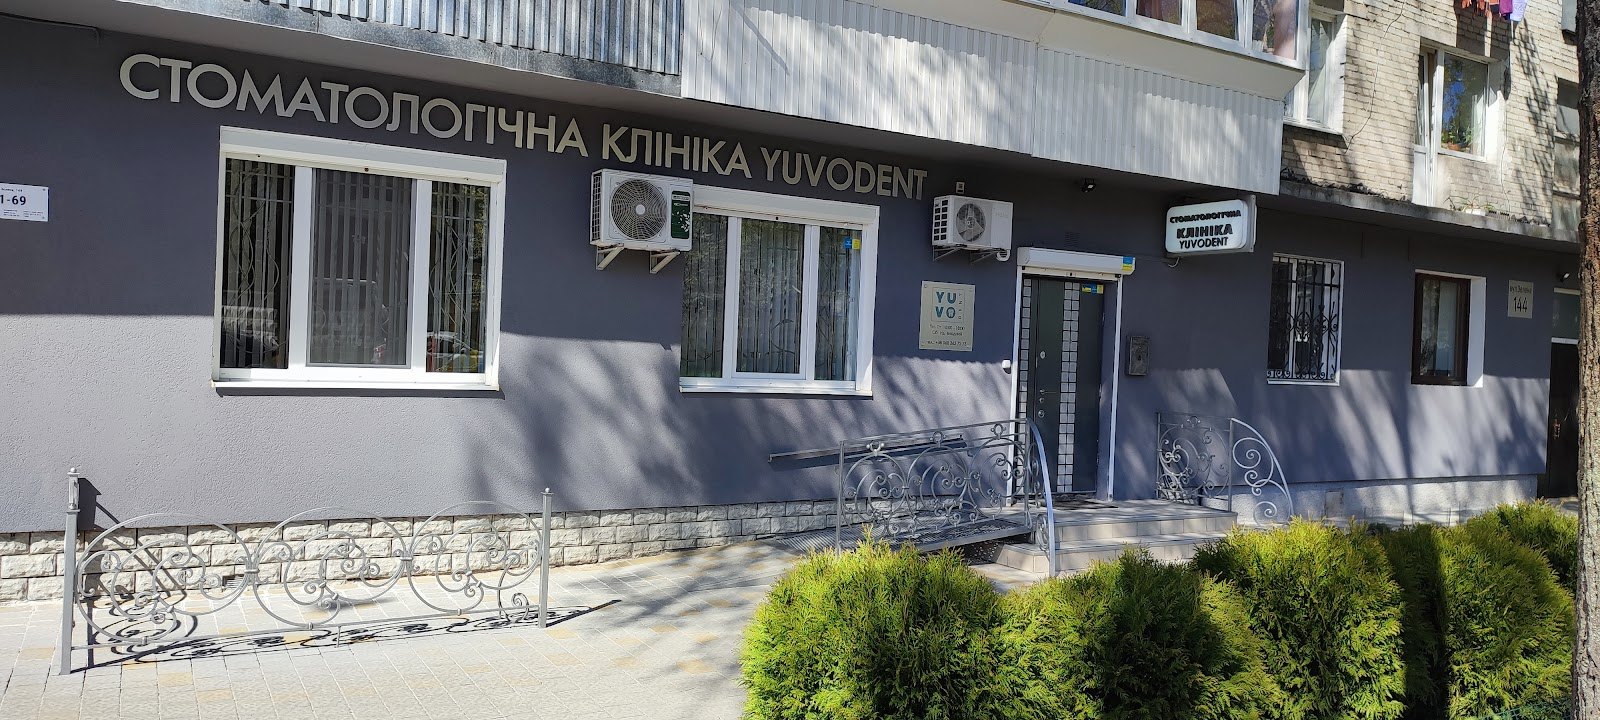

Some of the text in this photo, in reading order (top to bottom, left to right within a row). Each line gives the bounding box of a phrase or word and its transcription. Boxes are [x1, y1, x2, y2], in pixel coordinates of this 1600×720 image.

[119, 53, 928, 200] СТОМАТОЛОГІЧНА КЛІНІКА YUVODENT
[1170, 210, 1241, 223] СТОМАТОЛОГІЧНА
[1177, 224, 1233, 239] КЛІНІКА
[1180, 237, 1228, 249] YUVODENT
[936, 292, 956, 304] YU
[1514, 297, 1527, 312] 144
[936, 306, 955, 318] VO
